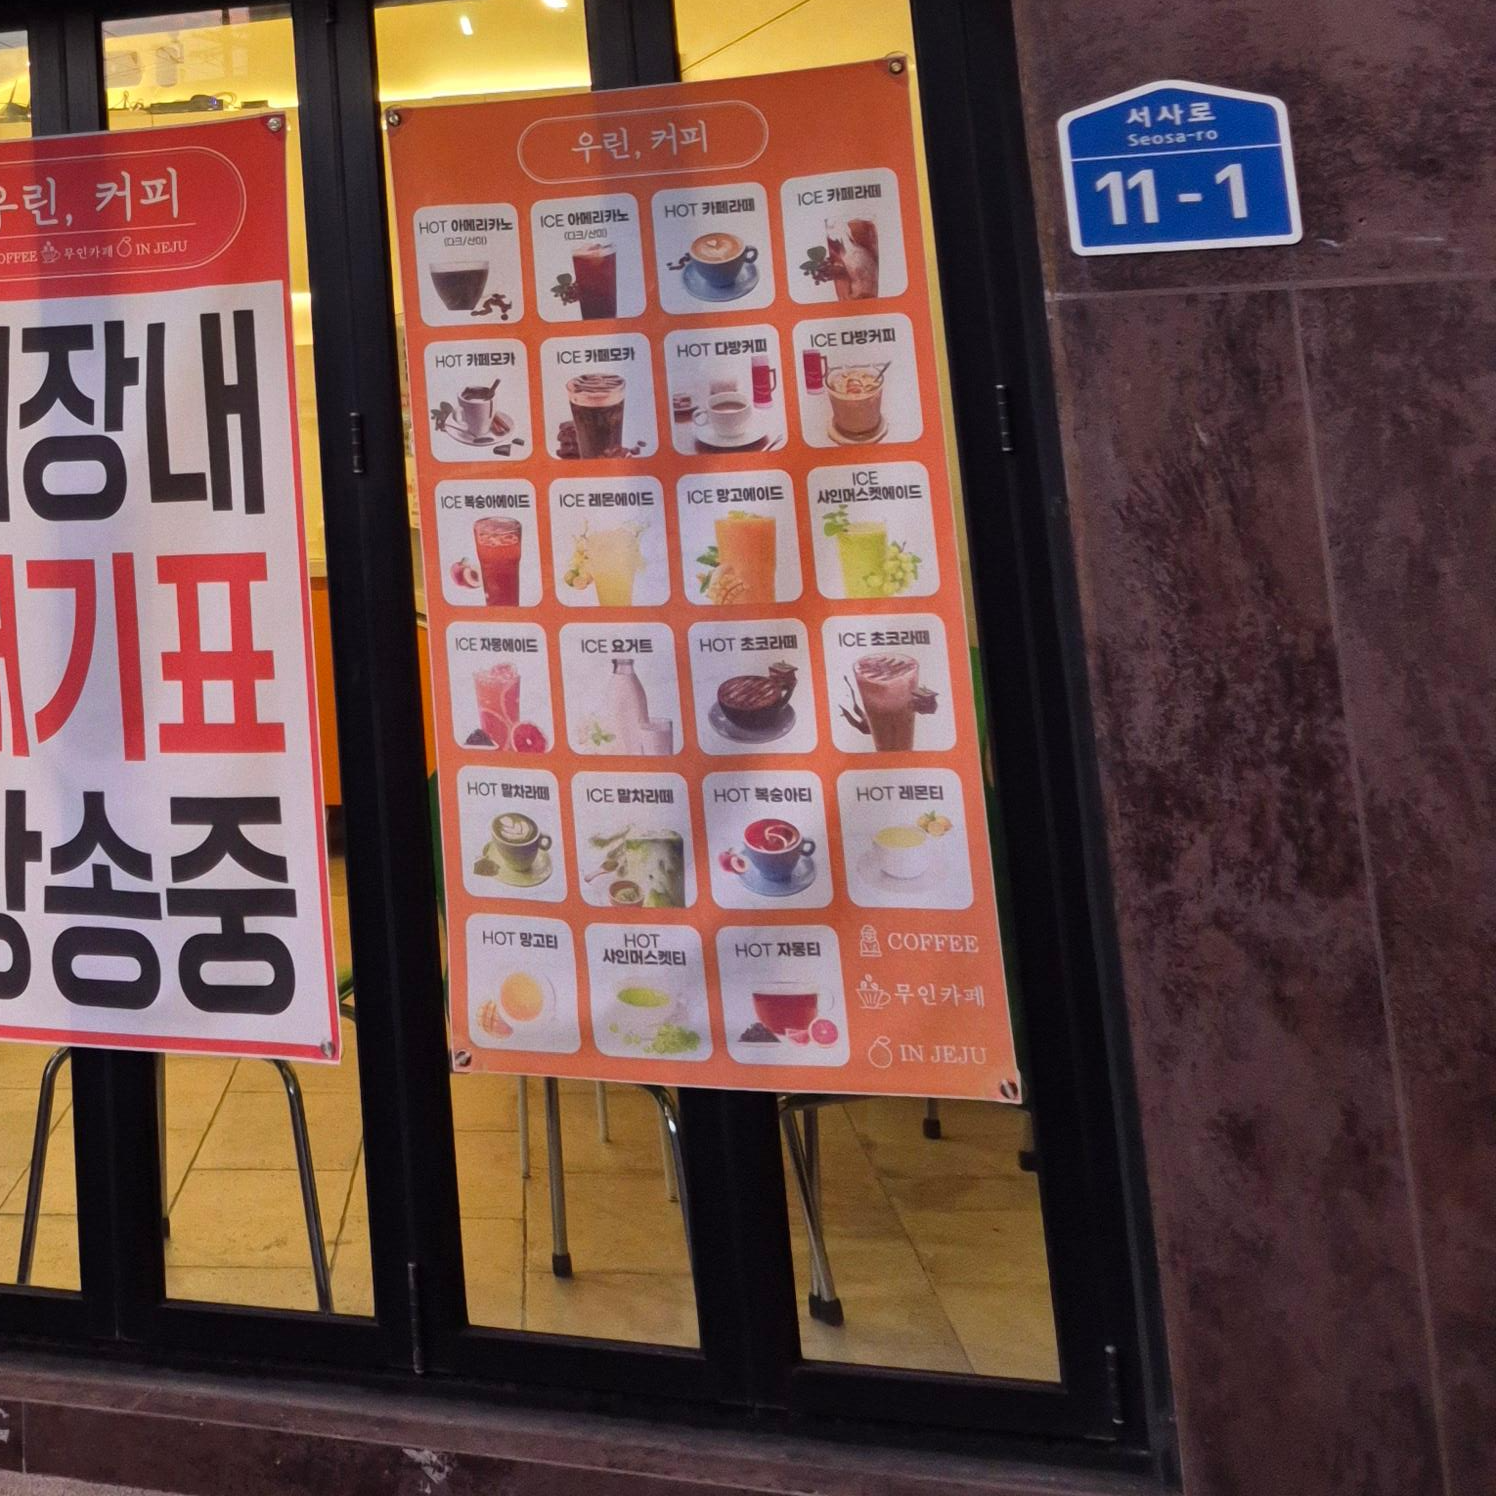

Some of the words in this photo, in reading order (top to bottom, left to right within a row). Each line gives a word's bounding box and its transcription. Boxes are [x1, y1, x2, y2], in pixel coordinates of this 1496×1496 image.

[1126, 102, 1217, 128] 서사로
[571, 128, 641, 164] 우린,
[651, 120, 708, 156] 커피
[1126, 129, 1219, 147] Seosa-ro
[95, 167, 180, 223] 커피
[797, 190, 823, 207] ICE
[827, 183, 882, 202] 카페라떼
[664, 203, 698, 218] HOT
[702, 197, 755, 215] 카페라떼
[419, 220, 448, 234] HOT
[451, 218, 513, 233] 아메리카노
[540, 213, 564, 228] ICE
[567, 209, 630, 227] 아메리카노
[63, 244, 113, 261] 무인카페
[136, 243, 150, 255] IN
[153, 240, 187, 254] JEJU
[810, 333, 837, 348] ICE
[841, 328, 896, 346] 다방커피
[557, 351, 582, 365] ICE
[585, 347, 635, 363] 카페모카
[677, 343, 712, 358] HOT
[715, 338, 767, 355] 다방커피
[435, 354, 464, 368] HOT
[466, 351, 516, 368] 카페모카
[852, 471, 878, 486] ICE
[441, 495, 462, 509] ICE
[465, 494, 531, 509] 복숭아에이드
[559, 494, 585, 508] ICE
[588, 491, 655, 508] 레몬에이드
[687, 490, 713, 504] ICE
[716, 486, 784, 503] 망고에이드
[455, 637, 478, 652] ICE
[480, 638, 539, 653] 자몽에이드
[581, 639, 608, 654] ICE
[611, 639, 653, 653] 요거트
[699, 637, 736, 652] HOT
[740, 634, 798, 652] 초코라떼
[838, 632, 867, 647] ICE
[870, 630, 931, 646] 초코라떼
[467, 782, 499, 797] HOT
[501, 783, 550, 801] 말차라떼
[586, 788, 613, 803] ICE
[617, 788, 674, 805] 말차라떼
[714, 788, 751, 803] HOT
[755, 787, 812, 803] 복숭아티
[856, 786, 895, 801] HOT
[898, 785, 944, 801] 레몬티
[482, 931, 517, 946] HOT
[520, 932, 558, 949] 망고티
[624, 933, 660, 948] HOT
[887, 932, 980, 954] COFFEE
[735, 942, 772, 958] HOT
[776, 941, 821, 957] 자몽티
[894, 983, 985, 1009] 무인카페
[900, 1044, 922, 1062] IN
[930, 1045, 987, 1065] JEJU
